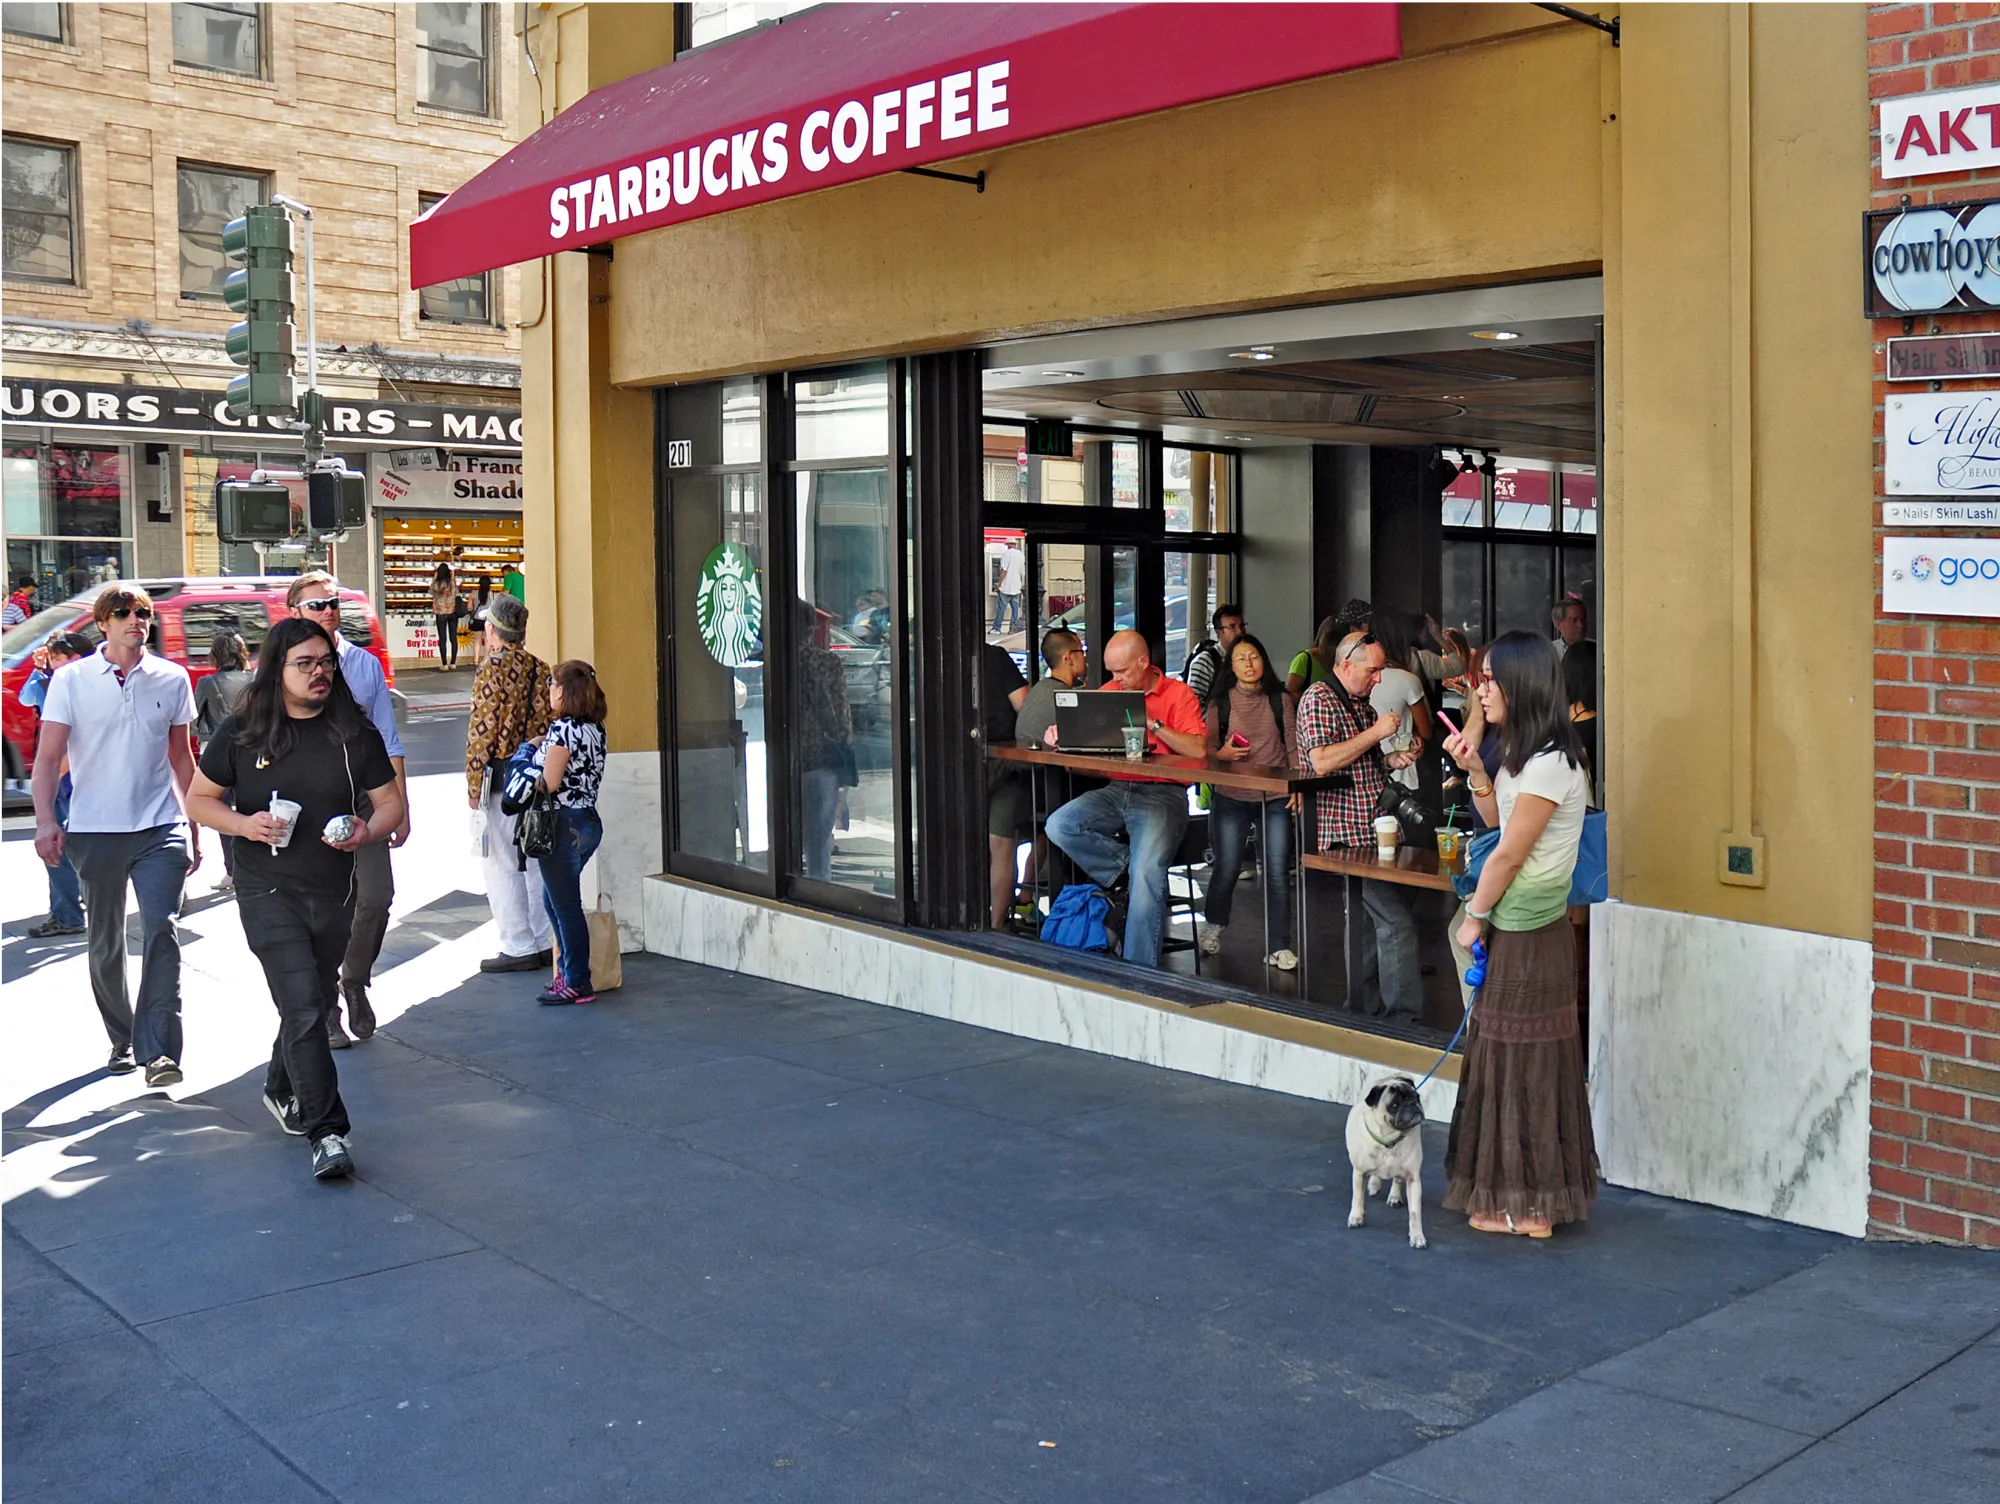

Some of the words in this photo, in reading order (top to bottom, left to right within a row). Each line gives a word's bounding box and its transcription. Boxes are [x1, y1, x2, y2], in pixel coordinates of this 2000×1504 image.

[1894, 104, 2000, 161] AKT
[549, 121, 788, 240] STARBUCKS
[799, 59, 1011, 173] COFFEE
[1896, 347, 1938, 371] Hair
[1945, 343, 2000, 368] Saon
[2, 387, 160, 422] UORS
[213, 400, 396, 435] CRS
[669, 441, 692, 467] 201
[1037, 426, 1068, 454] EXIT
[1936, 507, 1964, 519] Skin/
[1966, 507, 1998, 520] Lash/
[1938, 557, 2000, 586] goo
[407, 640, 420, 648] Buy
[418, 650, 434, 658] FREE
